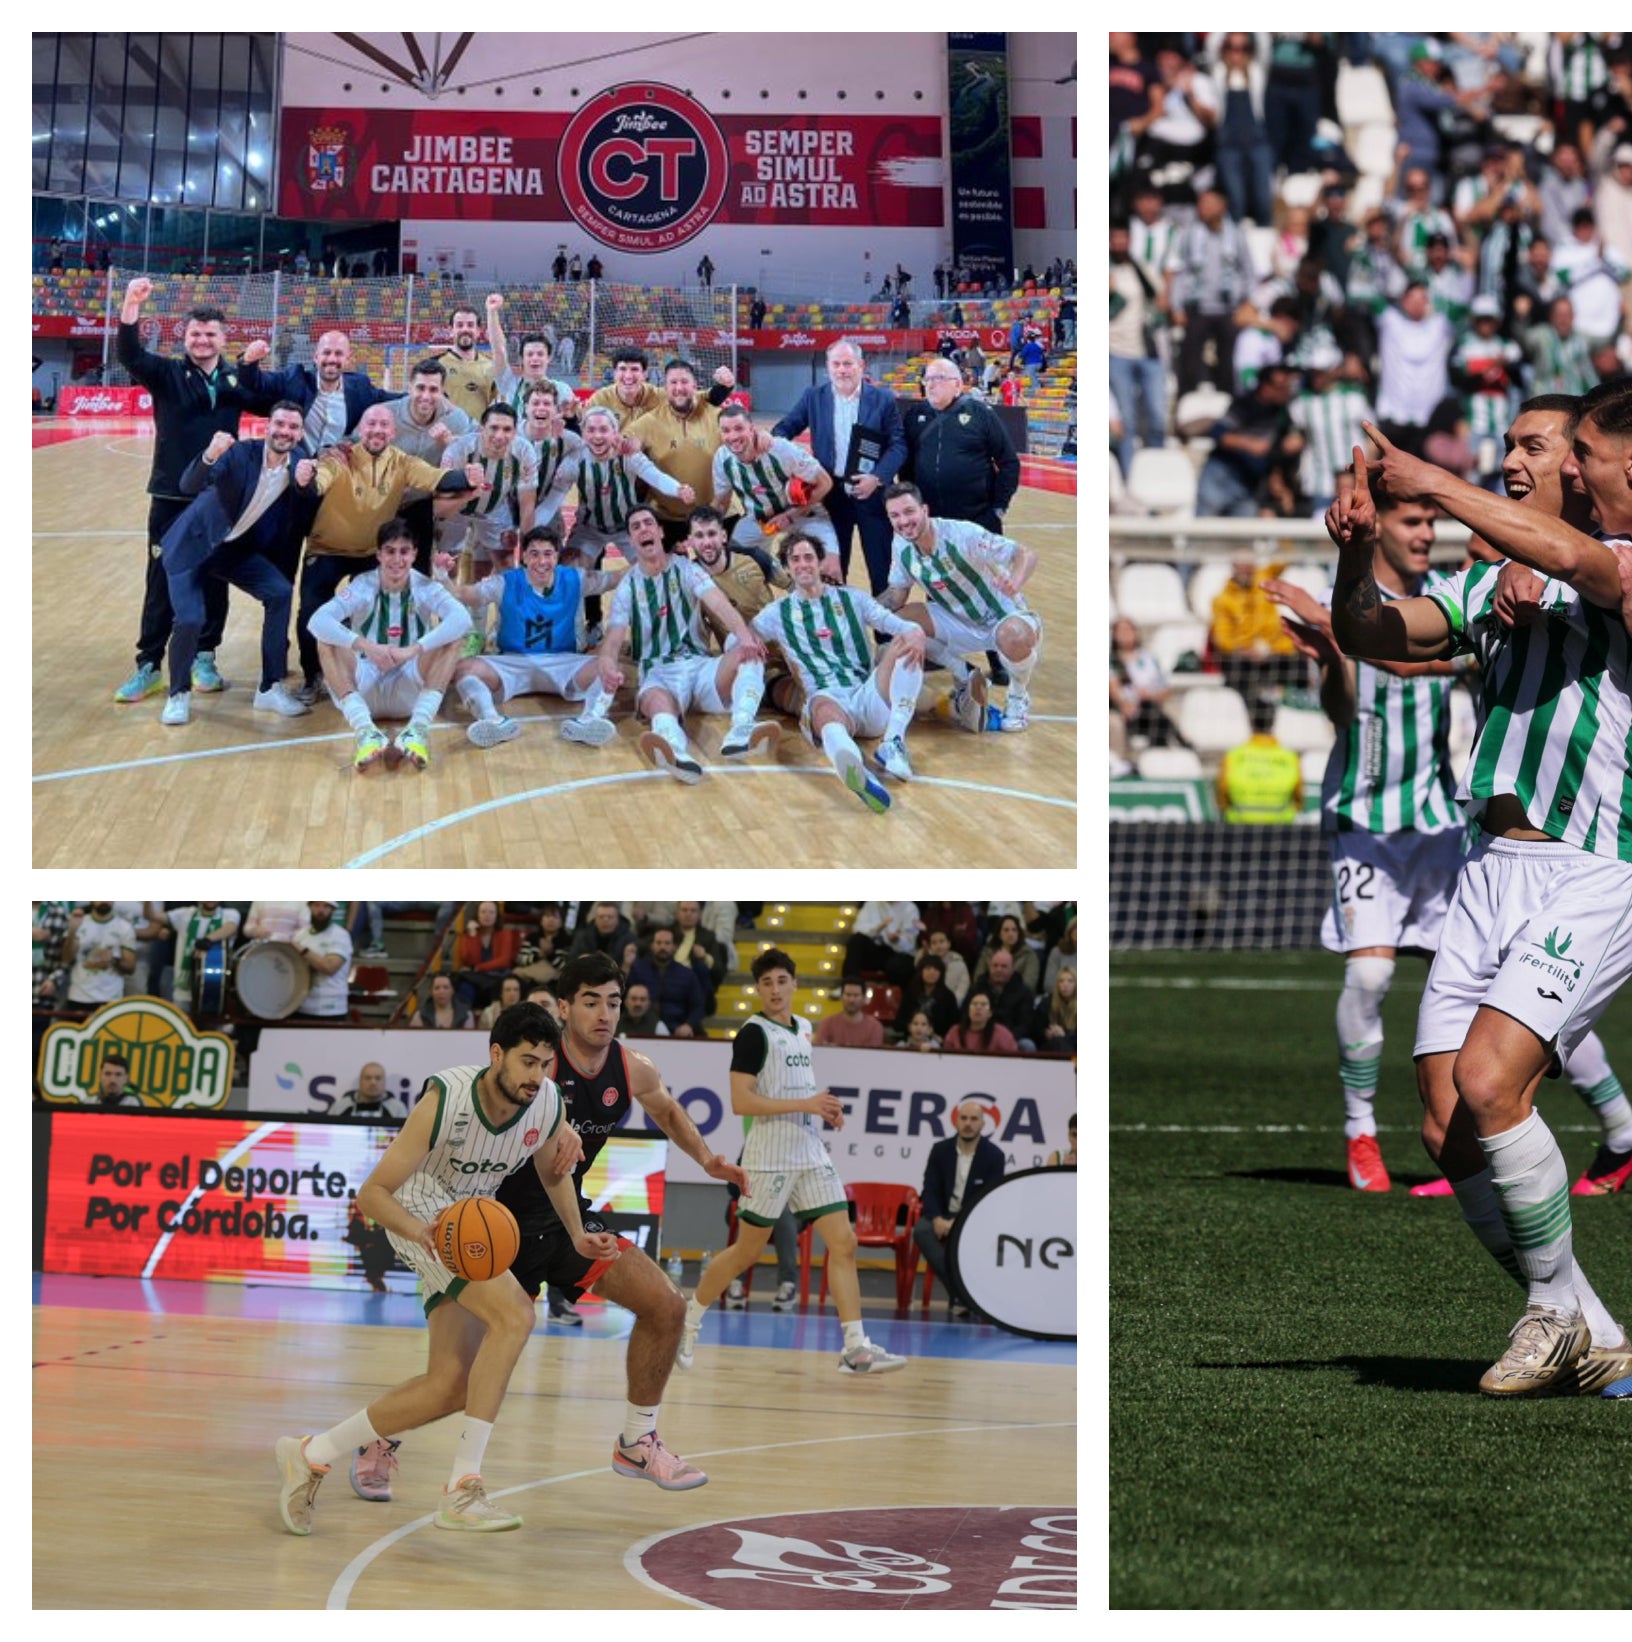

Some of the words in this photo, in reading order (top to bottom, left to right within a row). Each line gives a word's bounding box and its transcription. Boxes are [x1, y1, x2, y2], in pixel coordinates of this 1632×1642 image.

[404, 135, 513, 163] JIMBEE
[745, 130, 854, 155] SEMPER
[371, 165, 544, 195] CARTAGENA
[589, 138, 697, 201] CT
[757, 156, 842, 182] SIMUL
[608, 204, 678, 224] CARTAGENA
[741, 185, 766, 204] AD
[770, 183, 858, 208] ASTRA
[577, 205, 616, 239] SEMPER
[618, 233, 654, 247] SIMUL
[658, 232, 675, 245] AD
[677, 206, 710, 235] ASTRA
[1338, 862, 1375, 904] 22
[1518, 952, 1576, 993] iFertility
[87, 1153, 151, 1188] Por
[159, 1154, 190, 1190] el
[199, 1158, 357, 1203] Deporte.
[84, 1196, 149, 1232] Por
[156, 1196, 319, 1240] Córdoba.
[443, 1221, 460, 1275] Wilson
